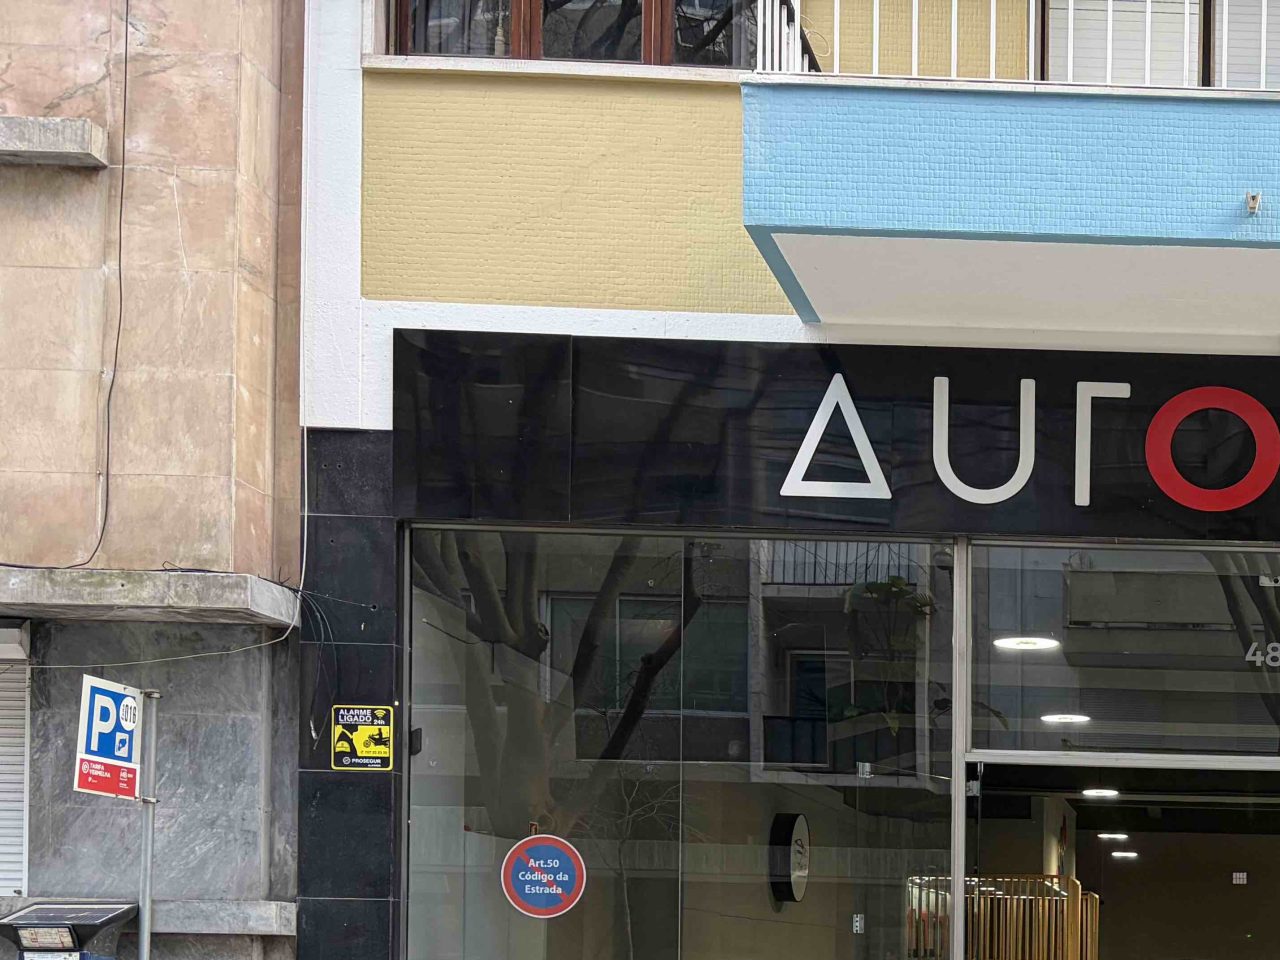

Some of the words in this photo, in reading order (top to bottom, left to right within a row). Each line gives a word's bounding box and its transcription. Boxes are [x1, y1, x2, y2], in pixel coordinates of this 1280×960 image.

[124, 705, 137, 724] 016
[91, 694, 117, 752] P
[528, 858, 560, 868] Art.50
[518, 871, 555, 883] Código
[555, 871, 569, 881] da
[525, 885, 562, 894] Estrada
